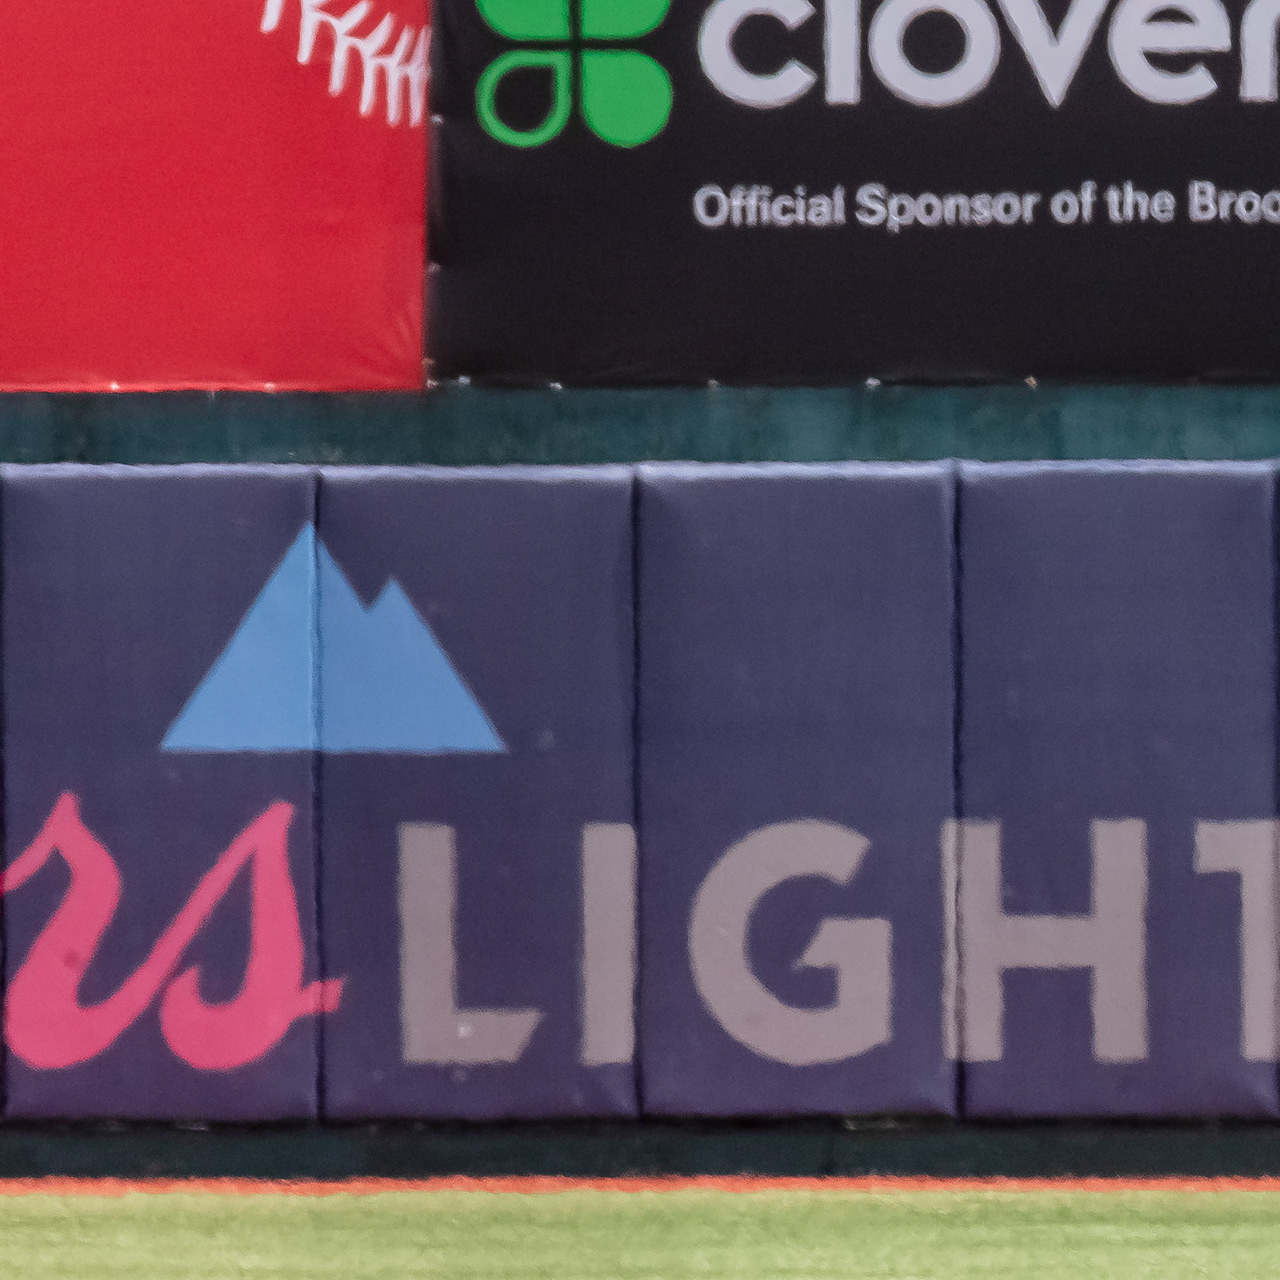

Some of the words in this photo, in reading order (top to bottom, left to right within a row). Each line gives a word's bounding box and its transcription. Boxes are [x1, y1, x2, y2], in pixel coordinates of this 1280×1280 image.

[693, 183, 846, 227] Official
[855, 182, 1041, 233] Sponsor
[1050, 180, 1098, 224] of
[1104, 180, 1176, 222] the
